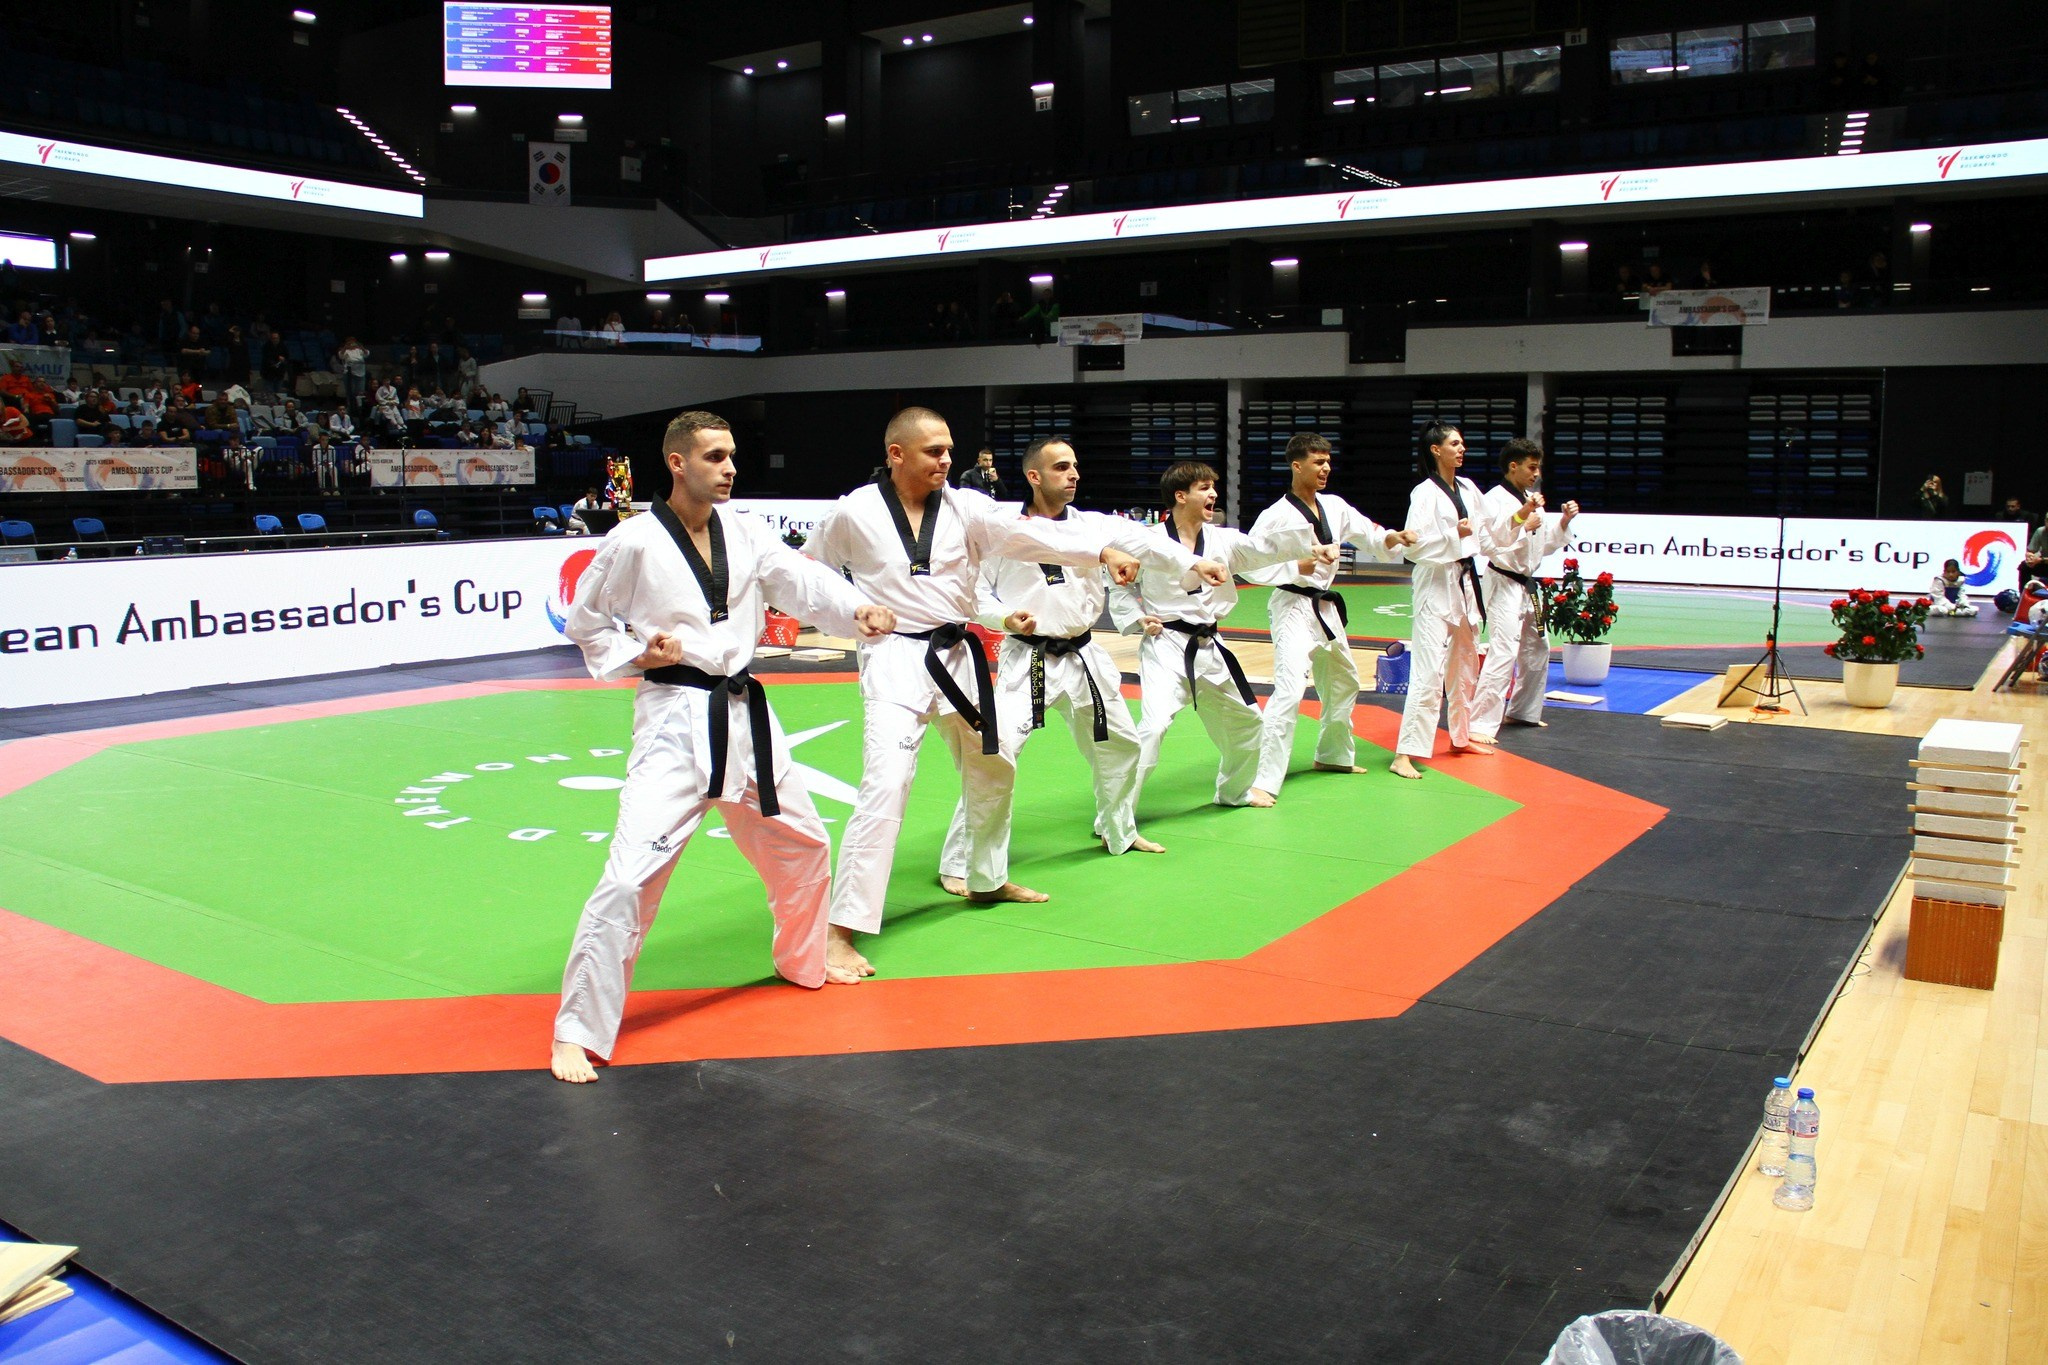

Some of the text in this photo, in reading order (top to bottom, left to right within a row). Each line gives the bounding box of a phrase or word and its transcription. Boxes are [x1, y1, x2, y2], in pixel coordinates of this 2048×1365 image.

[1039, 101, 1048, 110] B1
[1961, 153, 2008, 161] TAEKWONDO
[43, 466, 57, 475] CUP
[111, 466, 174, 475] AMBASSADOR'S CUP
[1663, 536, 1864, 562] Ambassador's
[1874, 541, 1930, 570] Cup
[0, 578, 522, 654] ean Ambassador's Cup
[394, 748, 625, 830] TAEKWOND
[651, 841, 672, 854] Daedo
